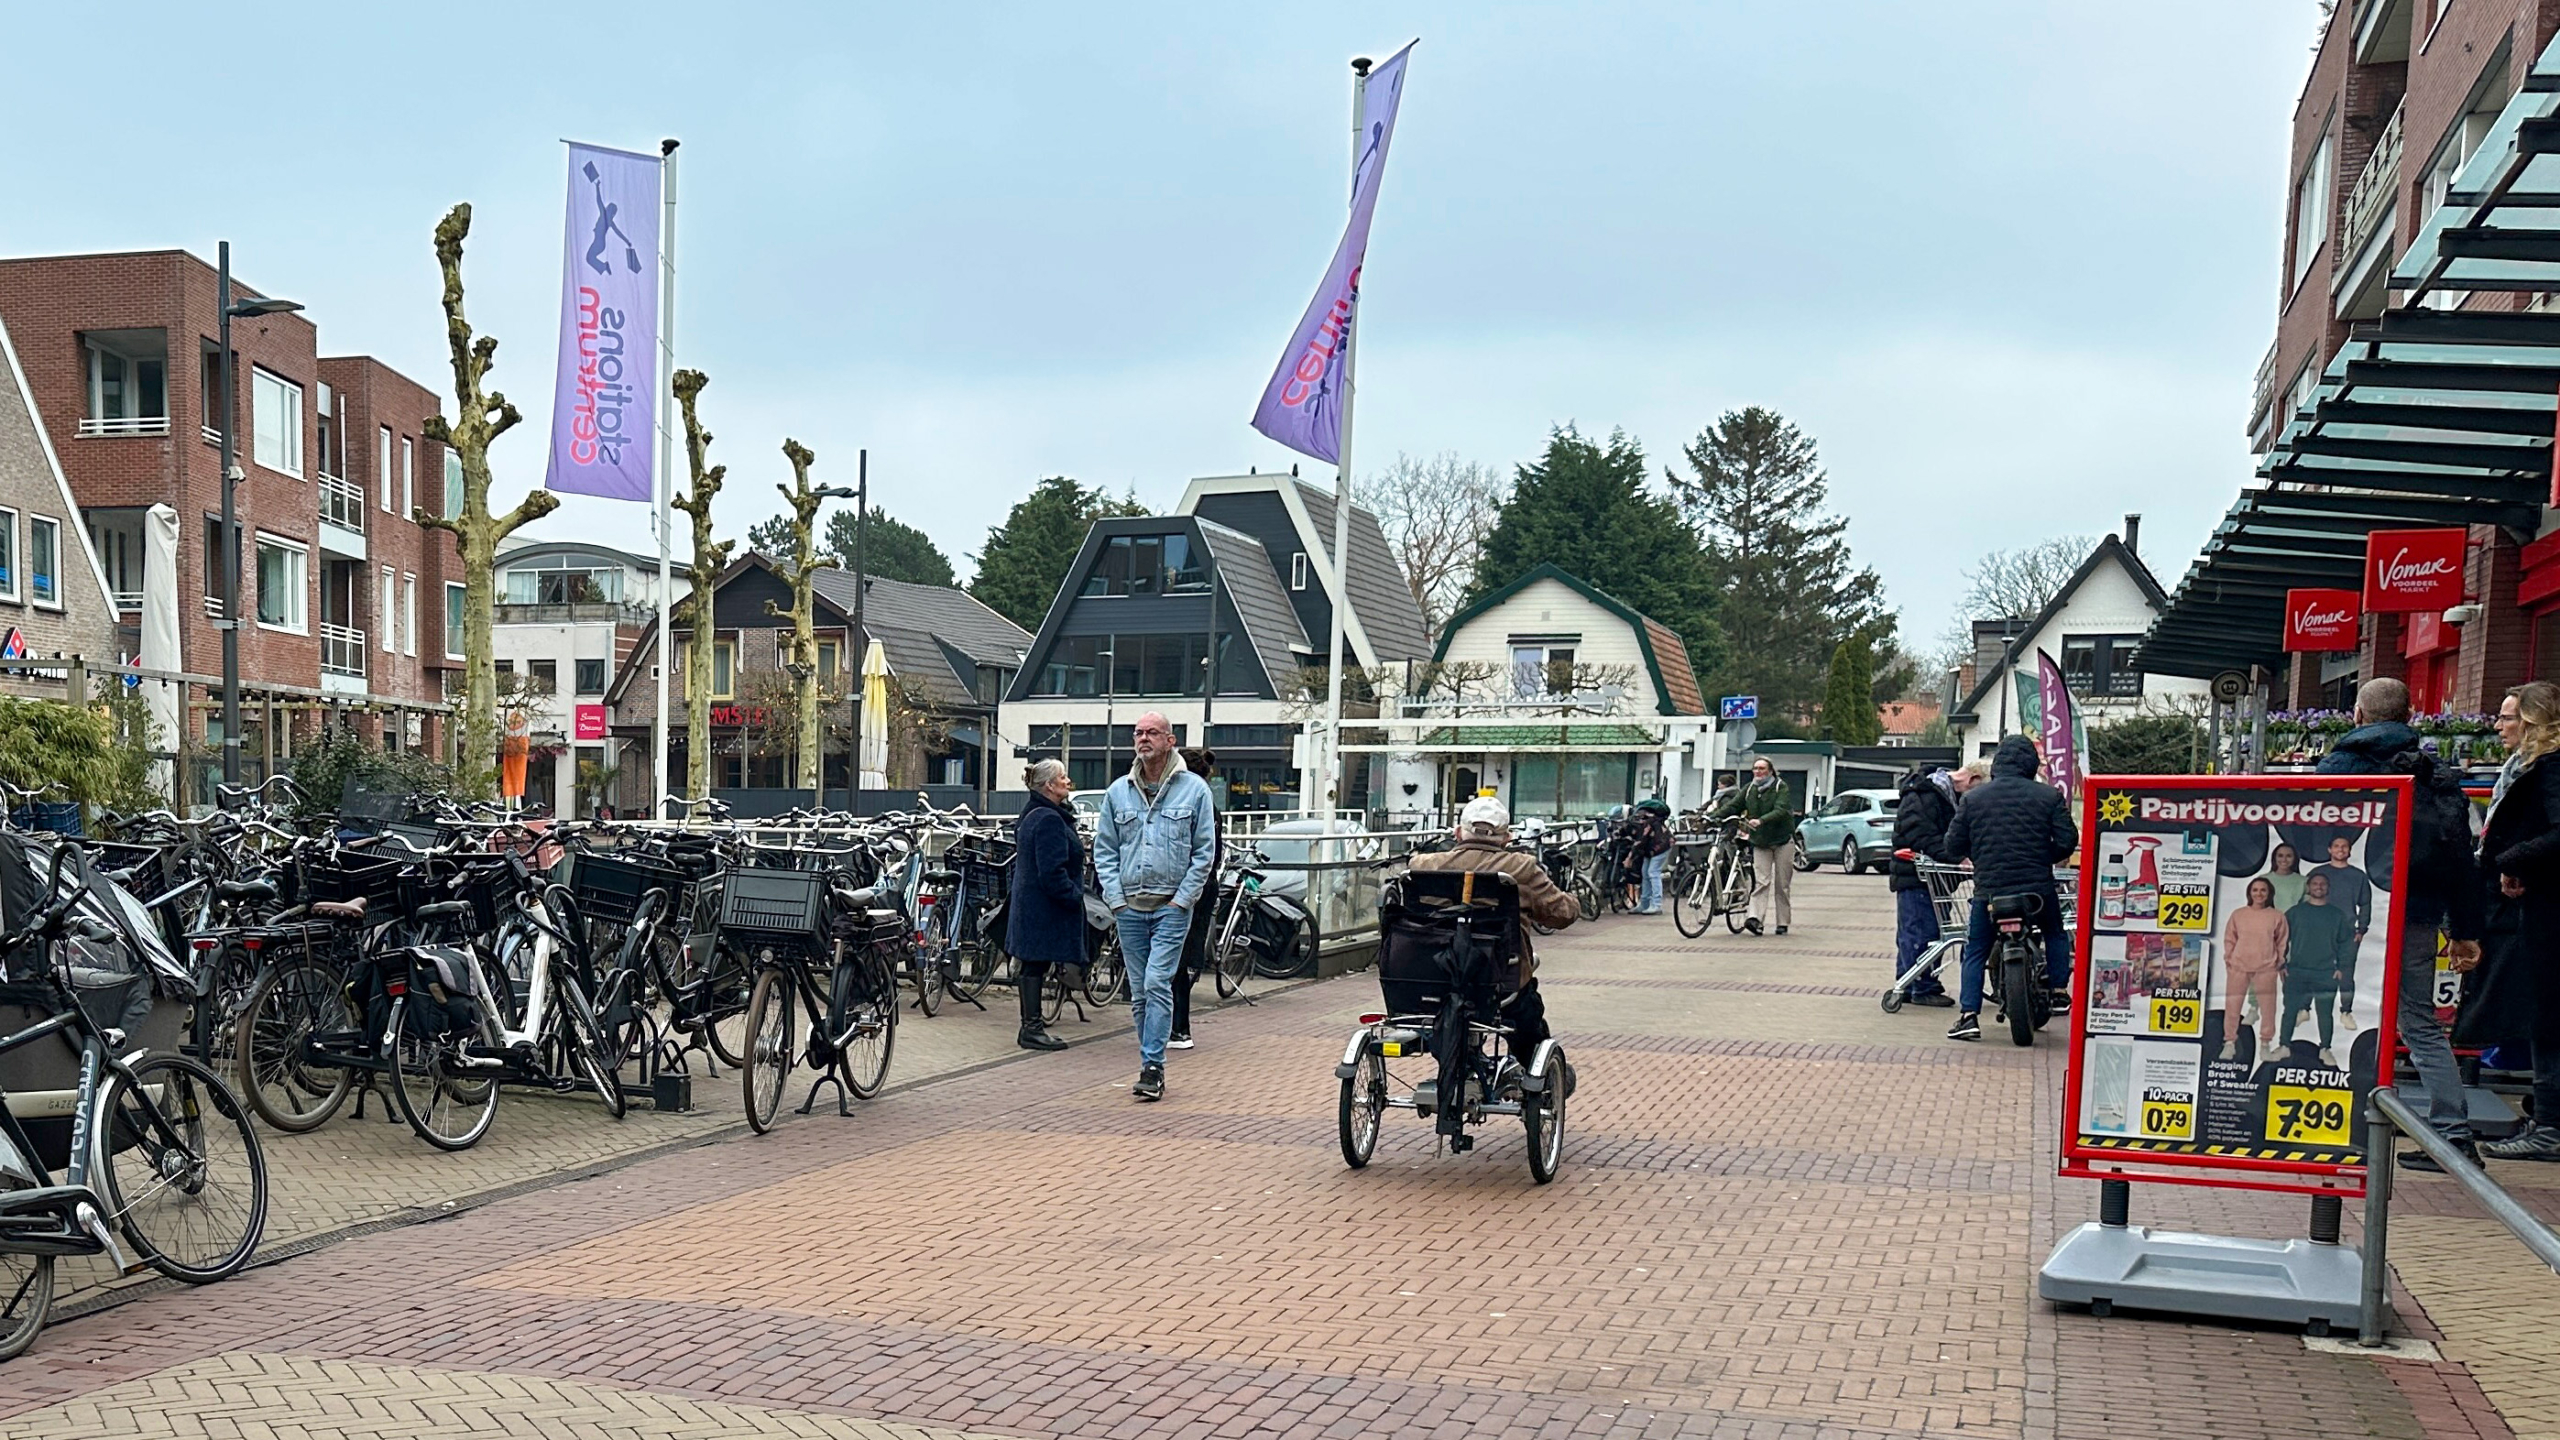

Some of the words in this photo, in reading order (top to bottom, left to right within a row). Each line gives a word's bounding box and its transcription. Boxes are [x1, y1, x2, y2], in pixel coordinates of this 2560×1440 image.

[2379, 547, 2457, 590] Vomar
[2294, 602, 2353, 634] Vomar
[2108, 799, 2123, 807] OP
[2140, 797, 2387, 826] Partijvoordeel!
[2163, 884, 2181, 894] PER
[2182, 885, 2208, 895] STUK
[2162, 901, 2204, 926] 2.99
[2155, 988, 2174, 998] PER
[2174, 988, 2199, 999] STUK
[2157, 1004, 2193, 1030] 1.99
[2207, 1070, 2237, 1079] Broek
[2208, 1061, 2249, 1072] Jogging
[2207, 1079, 2218, 1087] of
[2220, 1080, 2260, 1090] Sweater
[2275, 1067, 2306, 1084] PER
[2308, 1069, 2351, 1088] STUK
[2149, 1087, 2190, 1102] 10-PACK
[2146, 1107, 2187, 1133] 0.79
[2276, 1098, 2344, 1138] 7.99
